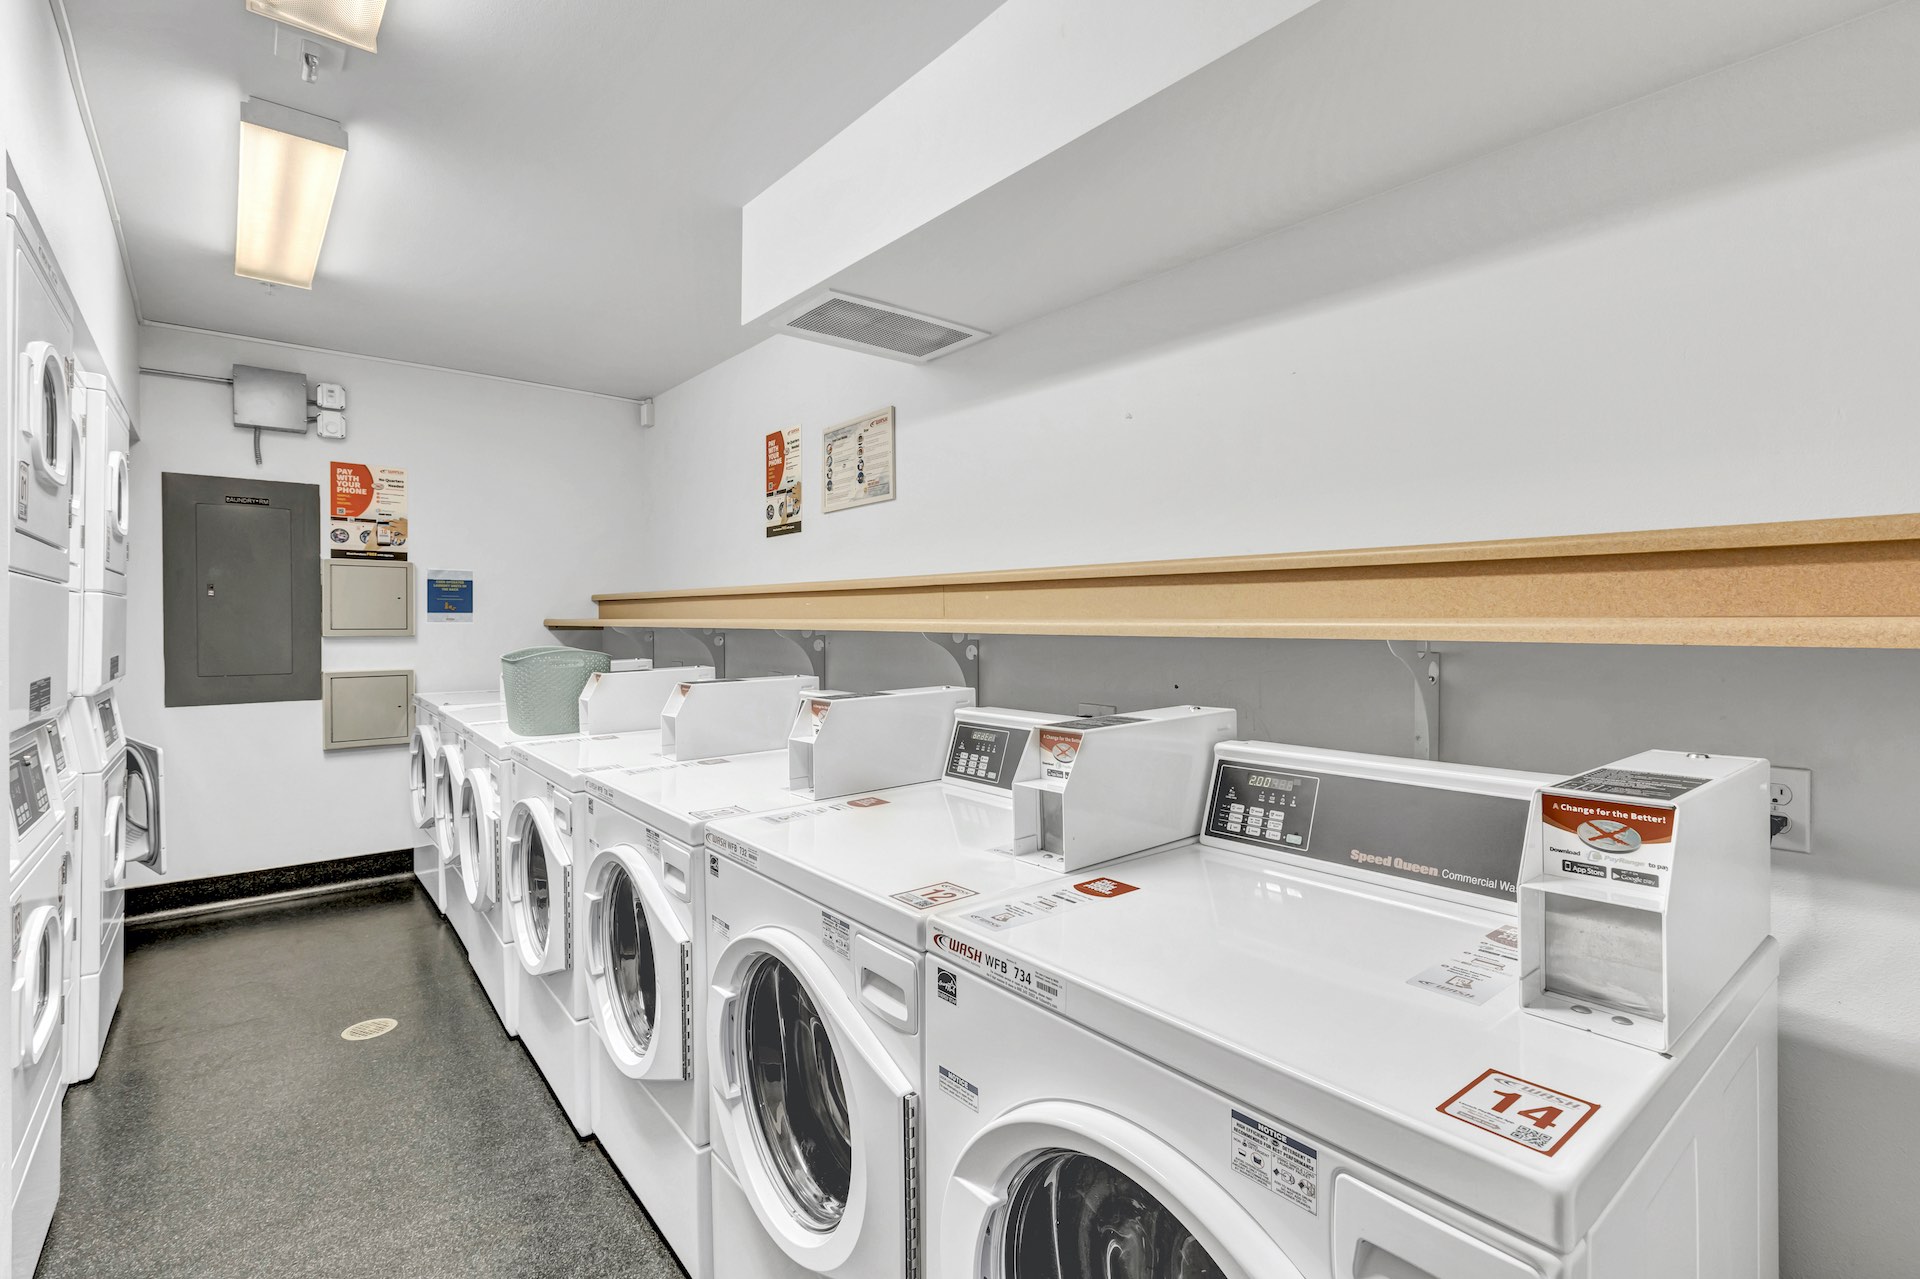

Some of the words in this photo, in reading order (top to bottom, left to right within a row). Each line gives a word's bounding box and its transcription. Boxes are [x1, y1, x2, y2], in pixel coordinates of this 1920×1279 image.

[337, 487, 367, 495] PHONE
[1248, 775, 1271, 788] 2.00
[1560, 804, 1594, 815] Change
[1596, 808, 1610, 816] for
[1612, 810, 1628, 819] the
[1630, 813, 1666, 824] Better!
[1550, 846, 1580, 856] Download
[1350, 850, 1392, 867] Speed
[1393, 858, 1439, 876] Queen
[1441, 869, 1497, 889] Commercial
[1587, 868, 1604, 877] Store
[1621, 874, 1642, 884] Google
[949, 938, 982, 963] WASH
[985, 953, 1007, 974] WFB
[1014, 967, 1031, 985] 734
[1491, 1090, 1556, 1129] 14
[1246, 1126, 1268, 1142] EFFICIENCY
[1282, 1144, 1305, 1160] DETERGENT
[1258, 1123, 1287, 1143] NOTICE
[1233, 1126, 1262, 1145] RECOMMENDED
[1272, 1146, 1281, 1155] BEST
[1283, 1151, 1313, 1172] PERFORMANCE
